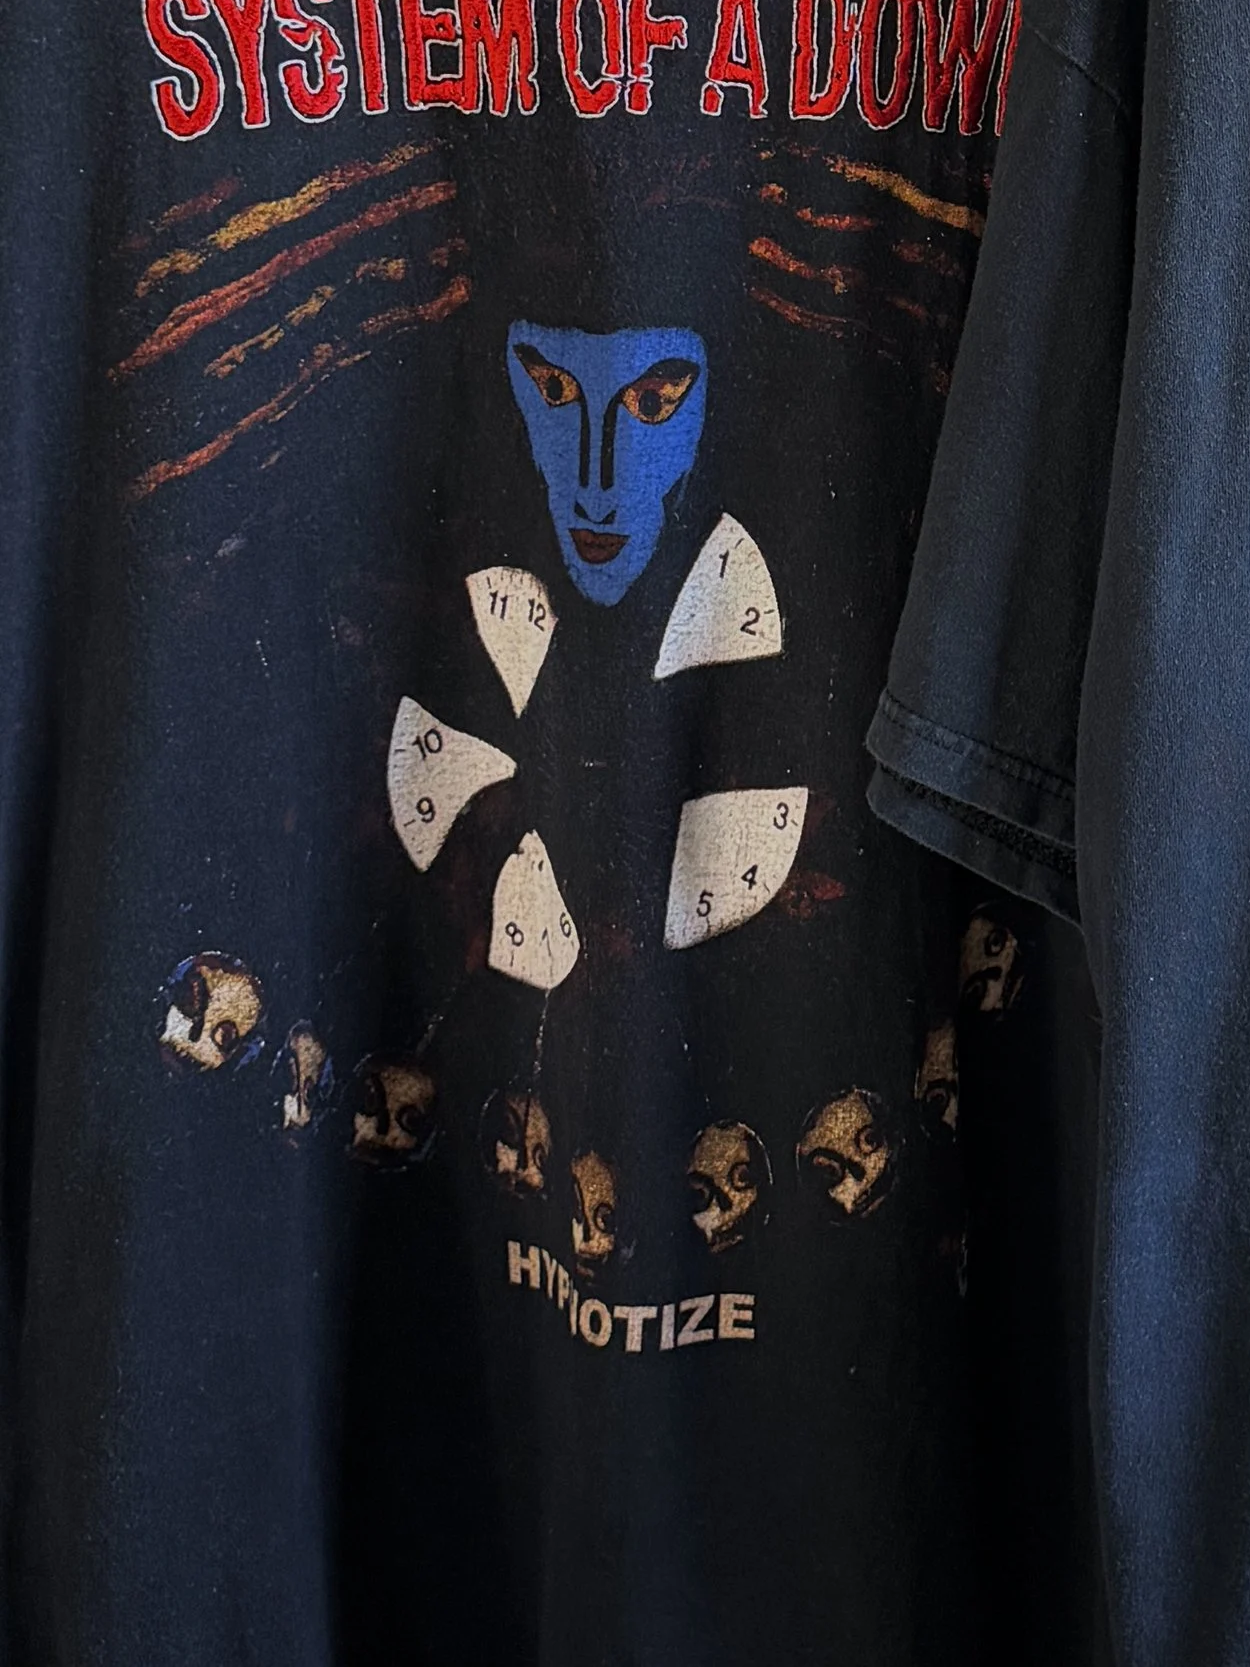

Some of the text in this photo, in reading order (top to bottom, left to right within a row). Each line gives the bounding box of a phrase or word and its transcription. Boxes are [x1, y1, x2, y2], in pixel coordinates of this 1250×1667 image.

[718, 550, 730, 578] 1
[489, 591, 546, 631] 11 12
[740, 607, 761, 635] 2
[411, 728, 443, 761] 10
[416, 796, 436, 824] 9
[772, 801, 789, 831] 3
[740, 865, 758, 890] 4
[696, 892, 713, 917] 5
[504, 921, 525, 947] 8
[559, 912, 572, 939] 6
